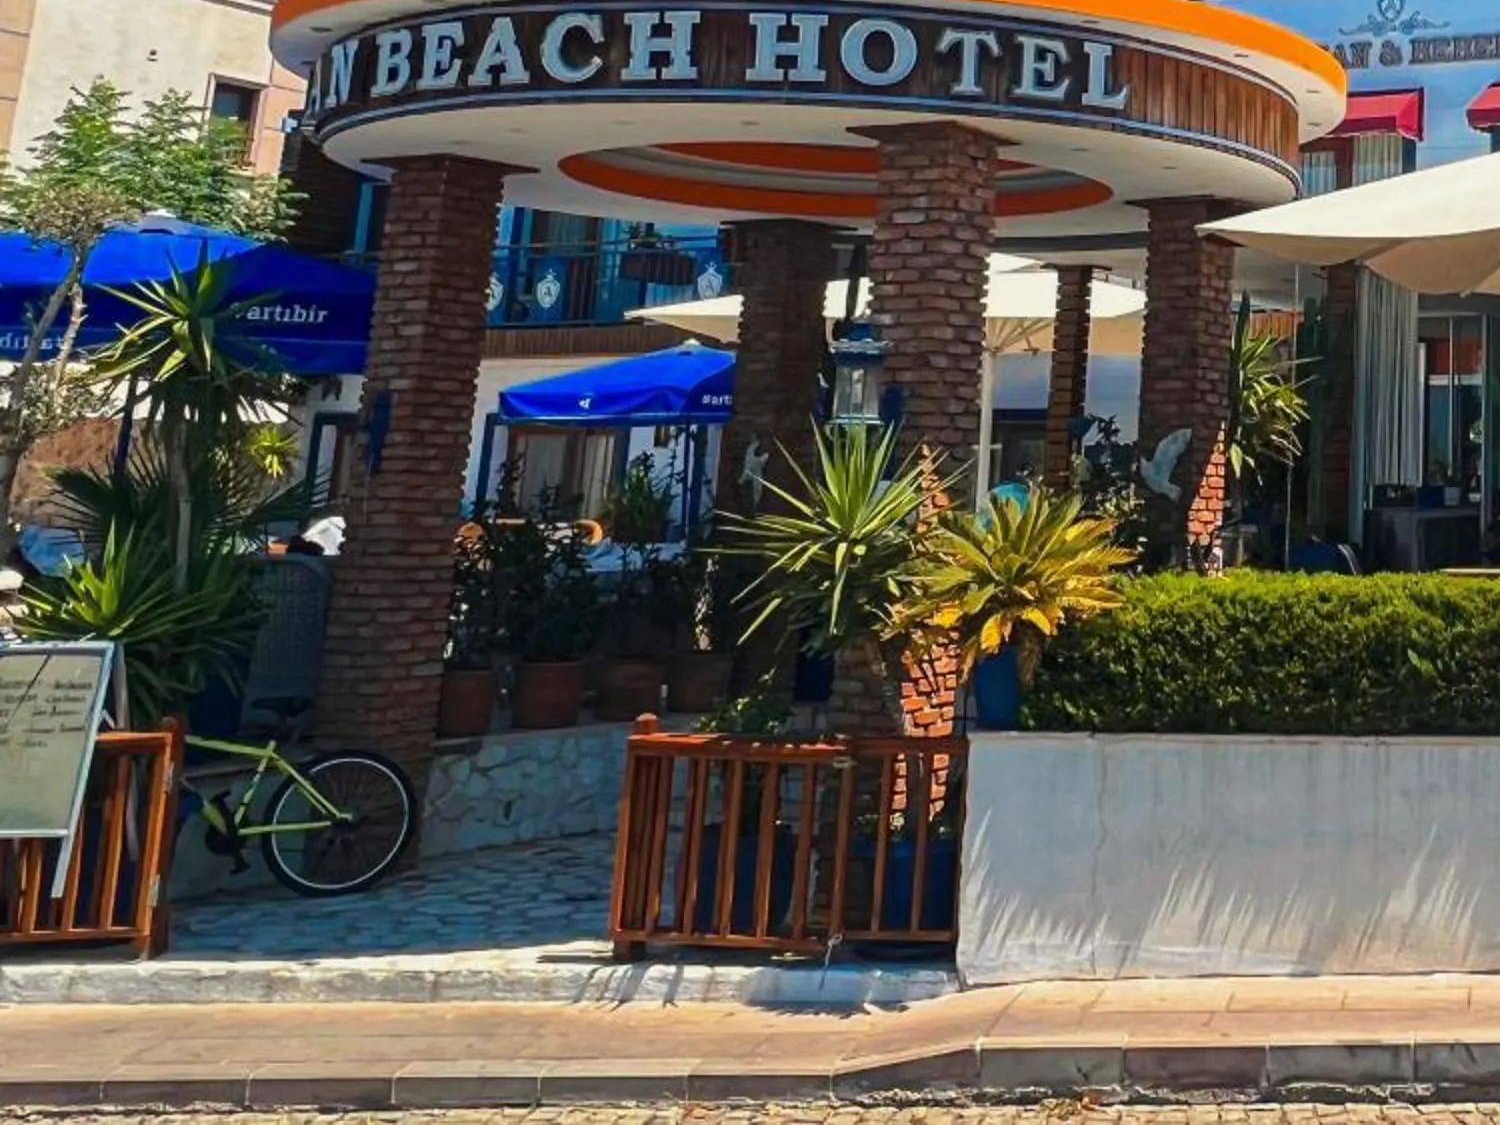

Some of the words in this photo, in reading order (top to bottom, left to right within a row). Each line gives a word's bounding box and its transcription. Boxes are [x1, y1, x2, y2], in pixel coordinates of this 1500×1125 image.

[370, 11, 700, 98] BEACH
[745, 12, 1129, 110] HOTEL
[1379, 40, 1404, 66] &
